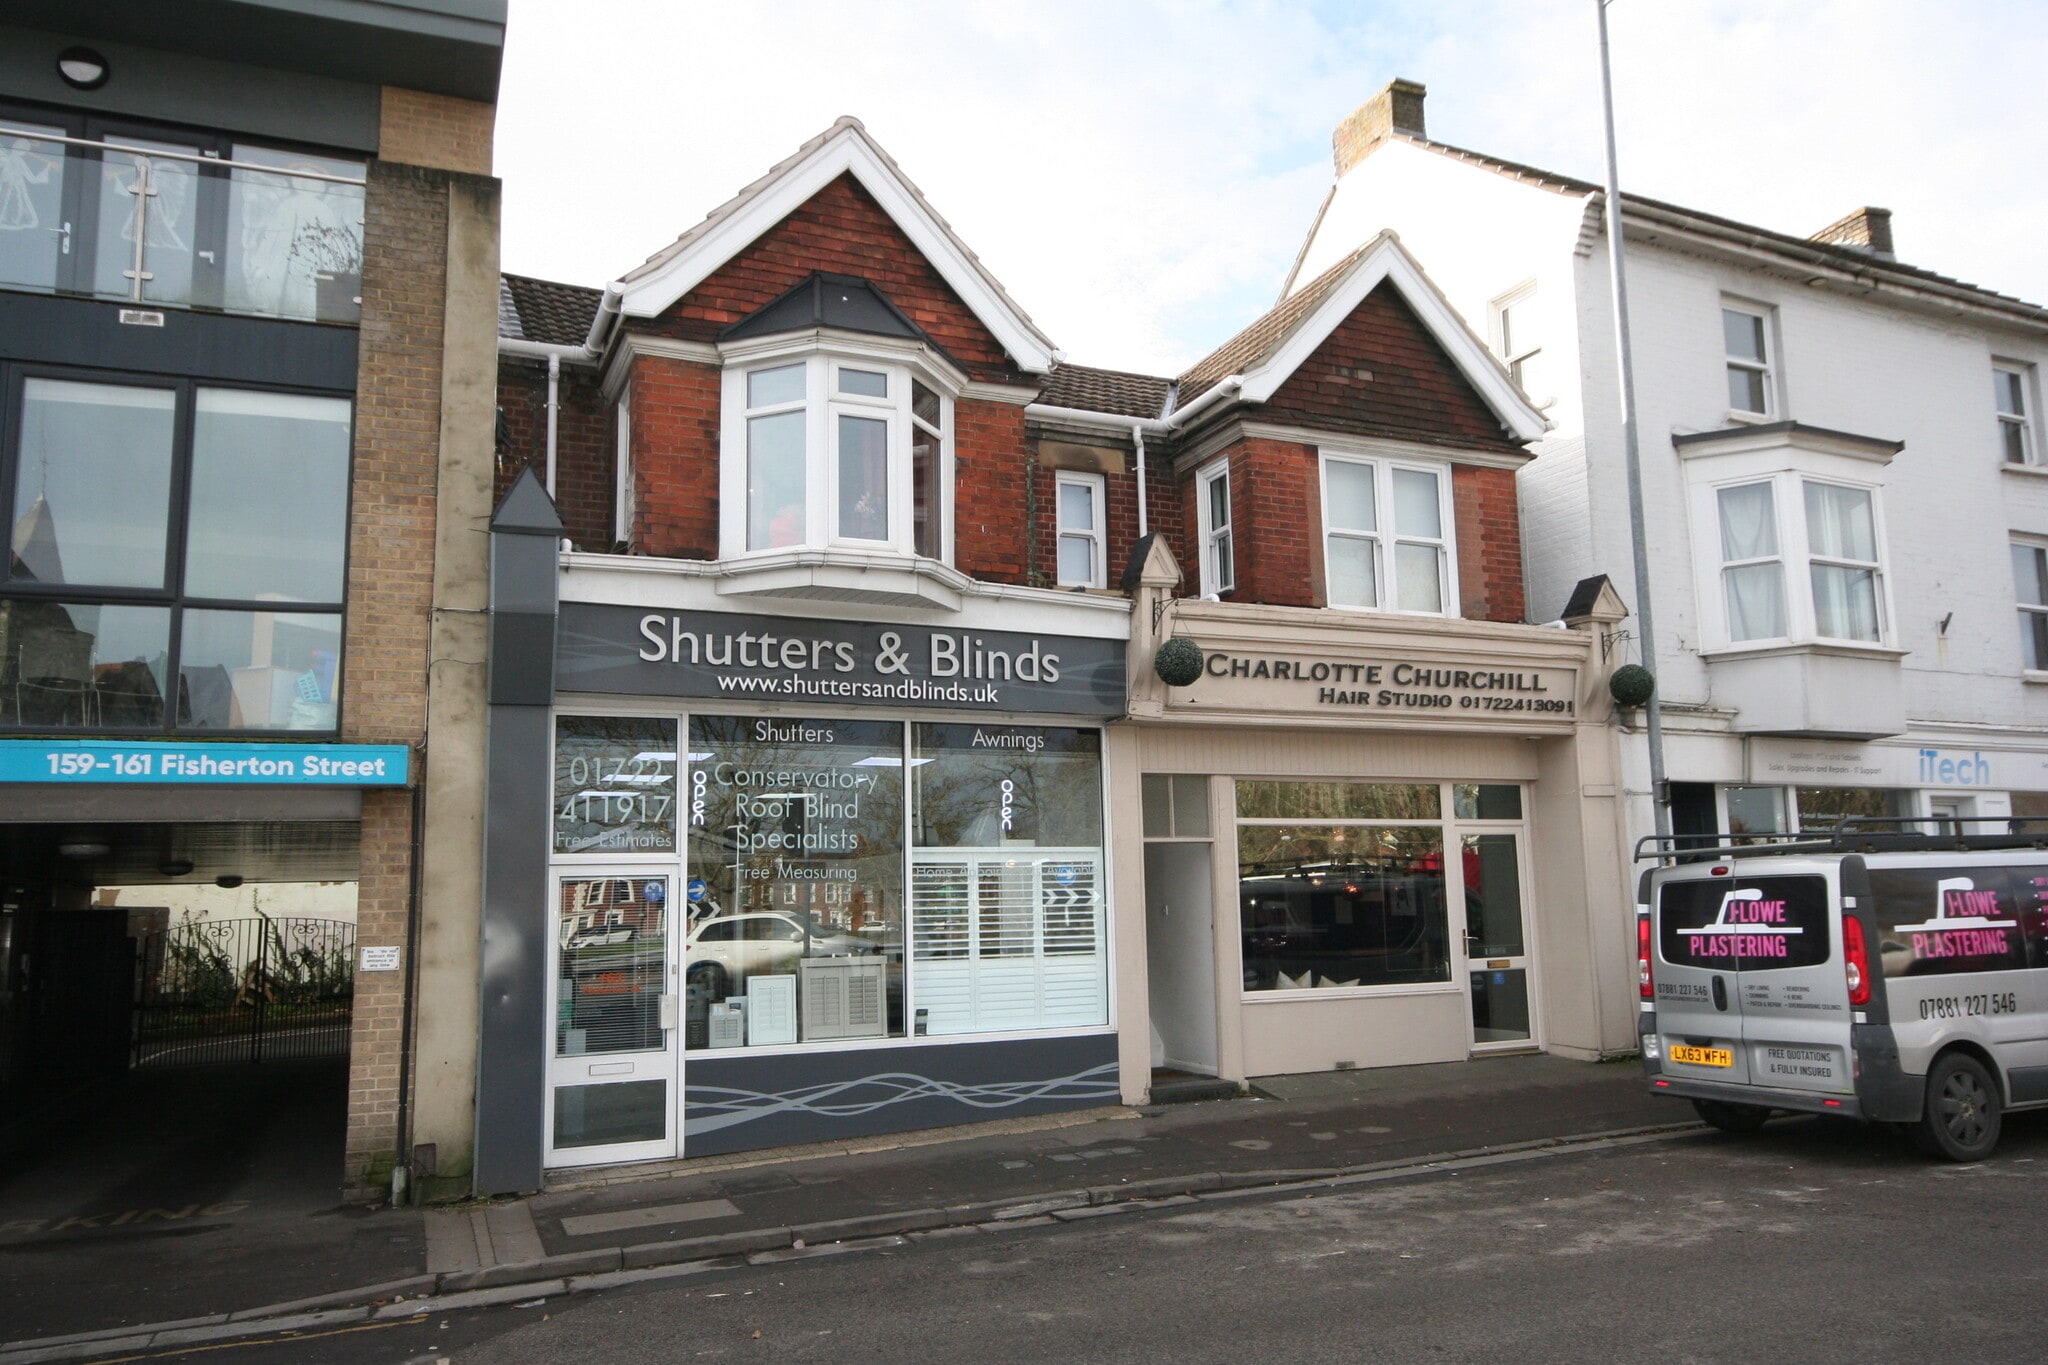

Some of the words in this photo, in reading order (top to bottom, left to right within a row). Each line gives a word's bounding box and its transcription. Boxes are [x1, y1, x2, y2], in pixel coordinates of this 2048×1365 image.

[638, 613, 855, 674] Shutters
[874, 630, 911, 676] &
[930, 632, 1061, 683] Blinds
[1206, 653, 1382, 685] CHARLOTTE
[1393, 663, 1548, 692] CHURCHILL
[717, 673, 999, 704] www.shuttersandblinds.uk
[1319, 687, 1370, 706] HAIR
[1378, 689, 1452, 709] STUDIO
[1460, 695, 1574, 714] 01722413091
[755, 719, 834, 743] Shutters
[971, 727, 1045, 753] Awnings
[46, 752, 151, 776] 159-161
[161, 756, 295, 777] Fisherton
[302, 756, 386, 777] Street
[569, 756, 662, 786] 01722
[714, 761, 879, 795] Conservatory
[1918, 748, 1990, 785] iTech
[558, 794, 672, 824] 411917
[692, 770, 707, 826] open
[736, 792, 794, 818] Roof
[806, 792, 859, 819] Blind
[1001, 779, 1014, 831] open
[556, 831, 591, 848] Free
[599, 831, 672, 848] Estimates
[736, 822, 859, 855] Specialists
[777, 863, 858, 883] Measuring
[1690, 935, 1788, 957] PLASTERING
[1911, 930, 2009, 959] PLASTERING
[1657, 983, 1677, 994] 07881
[1679, 984, 1692, 995] 227
[1693, 985, 1708, 997] 546
[1920, 997, 1962, 1020] 07881
[1965, 994, 1988, 1017] 227
[1992, 992, 2016, 1014] 546
[1674, 1047, 1702, 1062] LX63
[1704, 1049, 1727, 1065] WFH
[1767, 1048, 1785, 1059] FREE
[1786, 1048, 1832, 1063] QUOTATIONS
[1770, 1064, 1776, 1074] &
[1776, 1064, 1798, 1075] FULLY
[1800, 1065, 1832, 1078] INSURED
